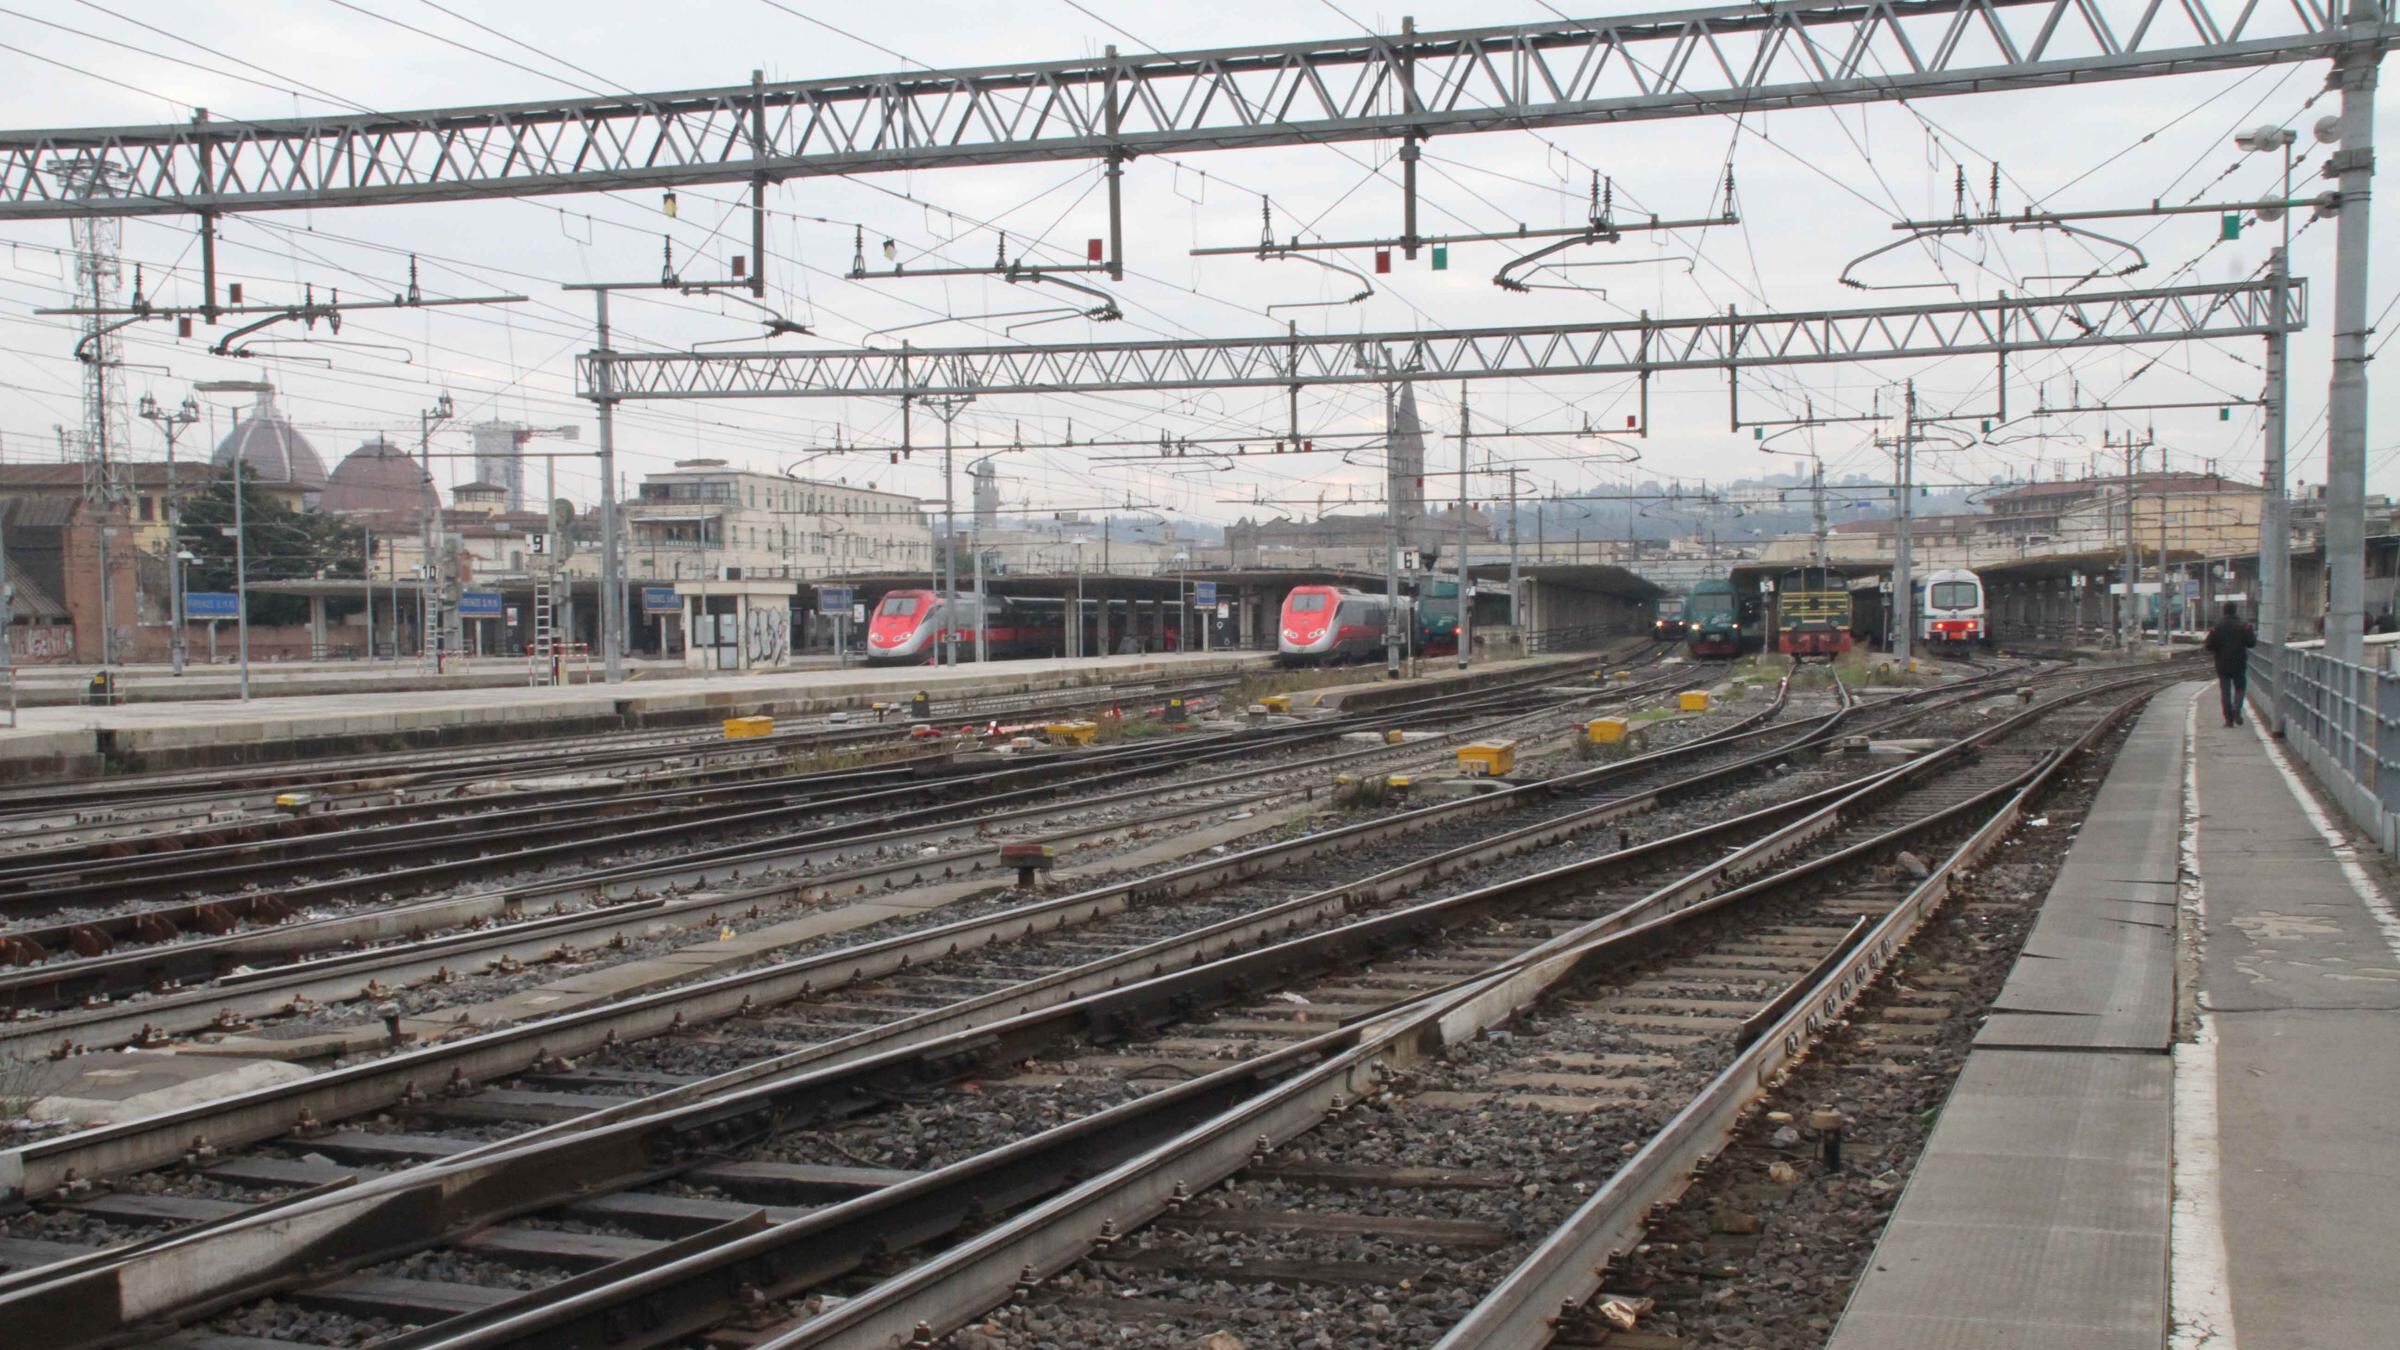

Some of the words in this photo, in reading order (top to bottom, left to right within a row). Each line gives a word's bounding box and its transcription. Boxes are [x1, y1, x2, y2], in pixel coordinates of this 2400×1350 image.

[533, 535, 543, 553] 9
[1404, 551, 1413, 569] 6
[423, 565, 437, 580] 10
